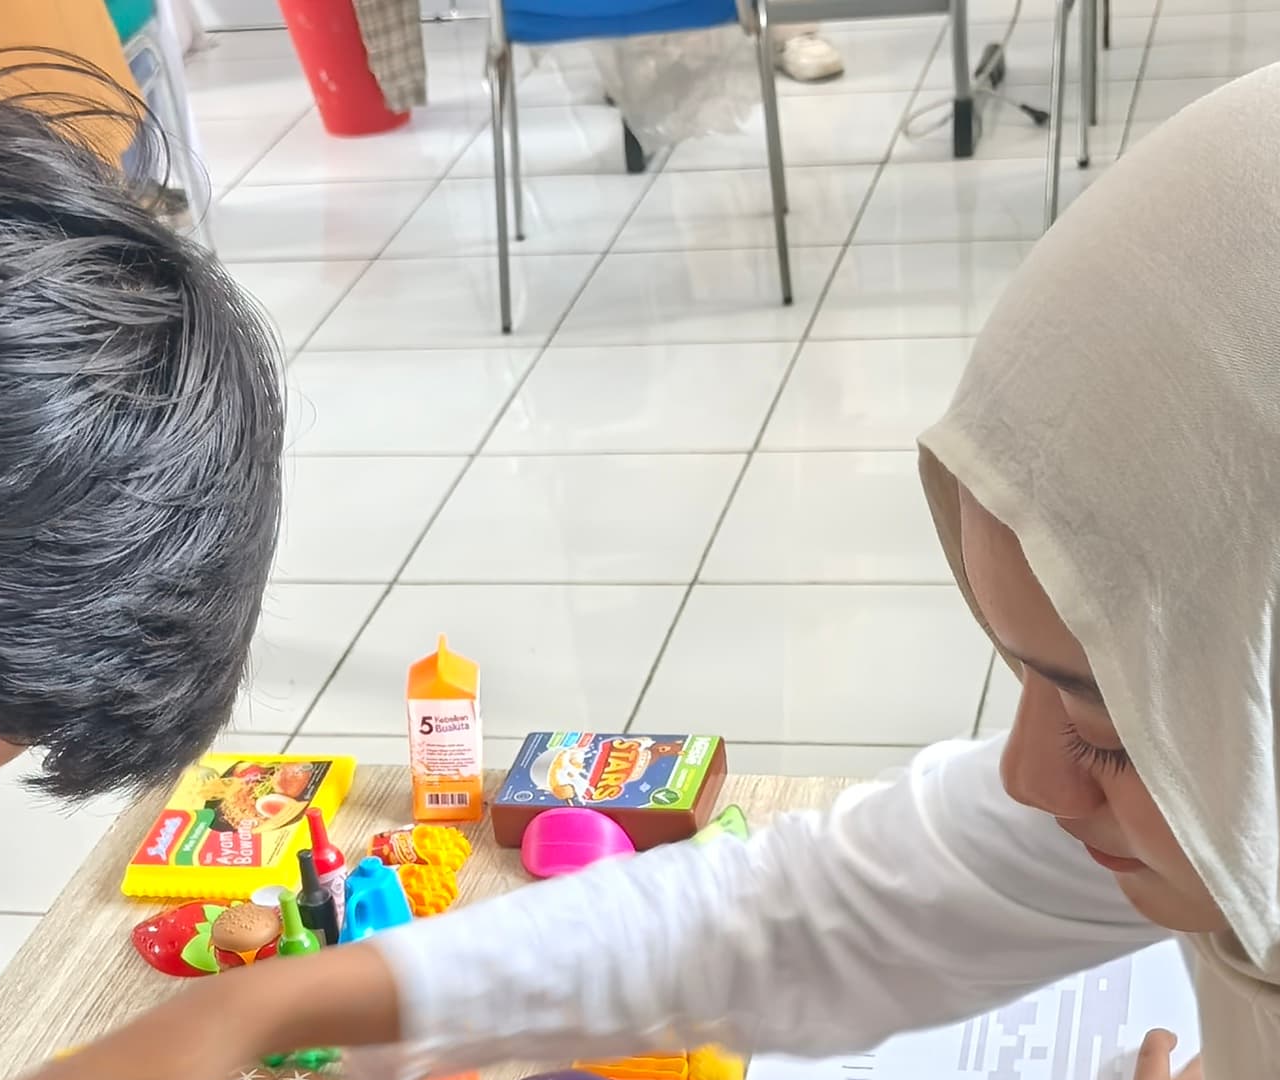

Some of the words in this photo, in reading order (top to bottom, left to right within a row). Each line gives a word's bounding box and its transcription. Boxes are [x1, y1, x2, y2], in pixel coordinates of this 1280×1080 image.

[419, 715, 433, 735] 5
[591, 739, 640, 801] STARS
[215, 830, 234, 864] Ayam
[233, 817, 259, 865] Bawang
